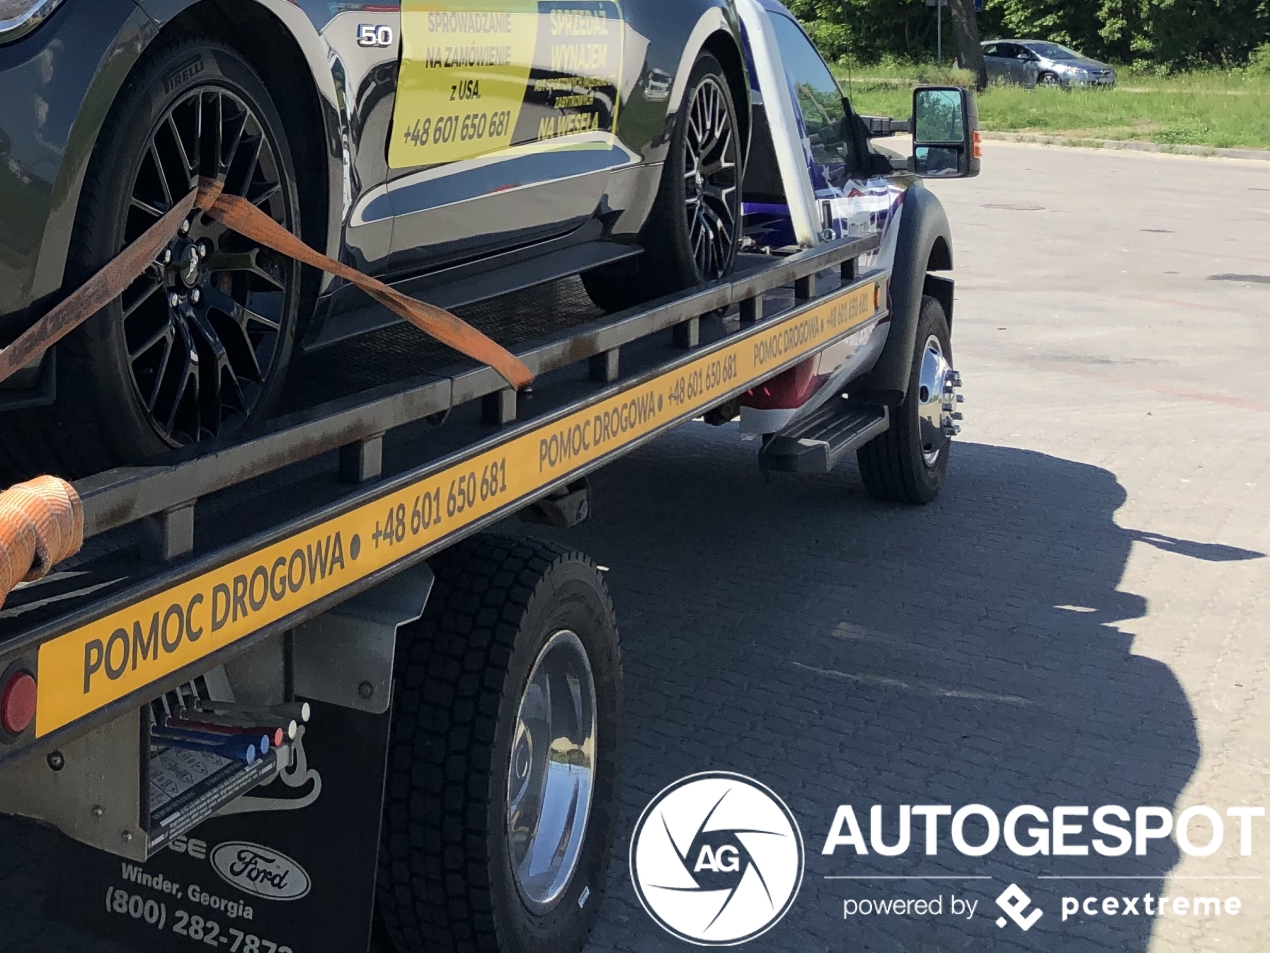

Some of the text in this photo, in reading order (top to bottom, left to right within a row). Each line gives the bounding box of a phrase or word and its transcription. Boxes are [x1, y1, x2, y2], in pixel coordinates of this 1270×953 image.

[428, 12, 512, 34] SPROWADZANIE
[163, 54, 206, 95] PIRELLI
[425, 41, 511, 69] NA ZAMÓWIENIE
[551, 44, 608, 71] WYNAJEM
[449, 85, 458, 102] z
[404, 110, 511, 147] +48 601 650 681
[537, 116, 556, 141] NA
[753, 332, 783, 368] POMOC
[783, 317, 820, 354] DROGOWA
[539, 354, 737, 473] POMOC DROGOWA +48 601 650 681
[83, 457, 508, 695] POMOC DROGOWA +48 601 650 681
[230, 849, 291, 890] Ford
[105, 886, 167, 930] (800)
[121, 862, 254, 920] Winder, Georgia
